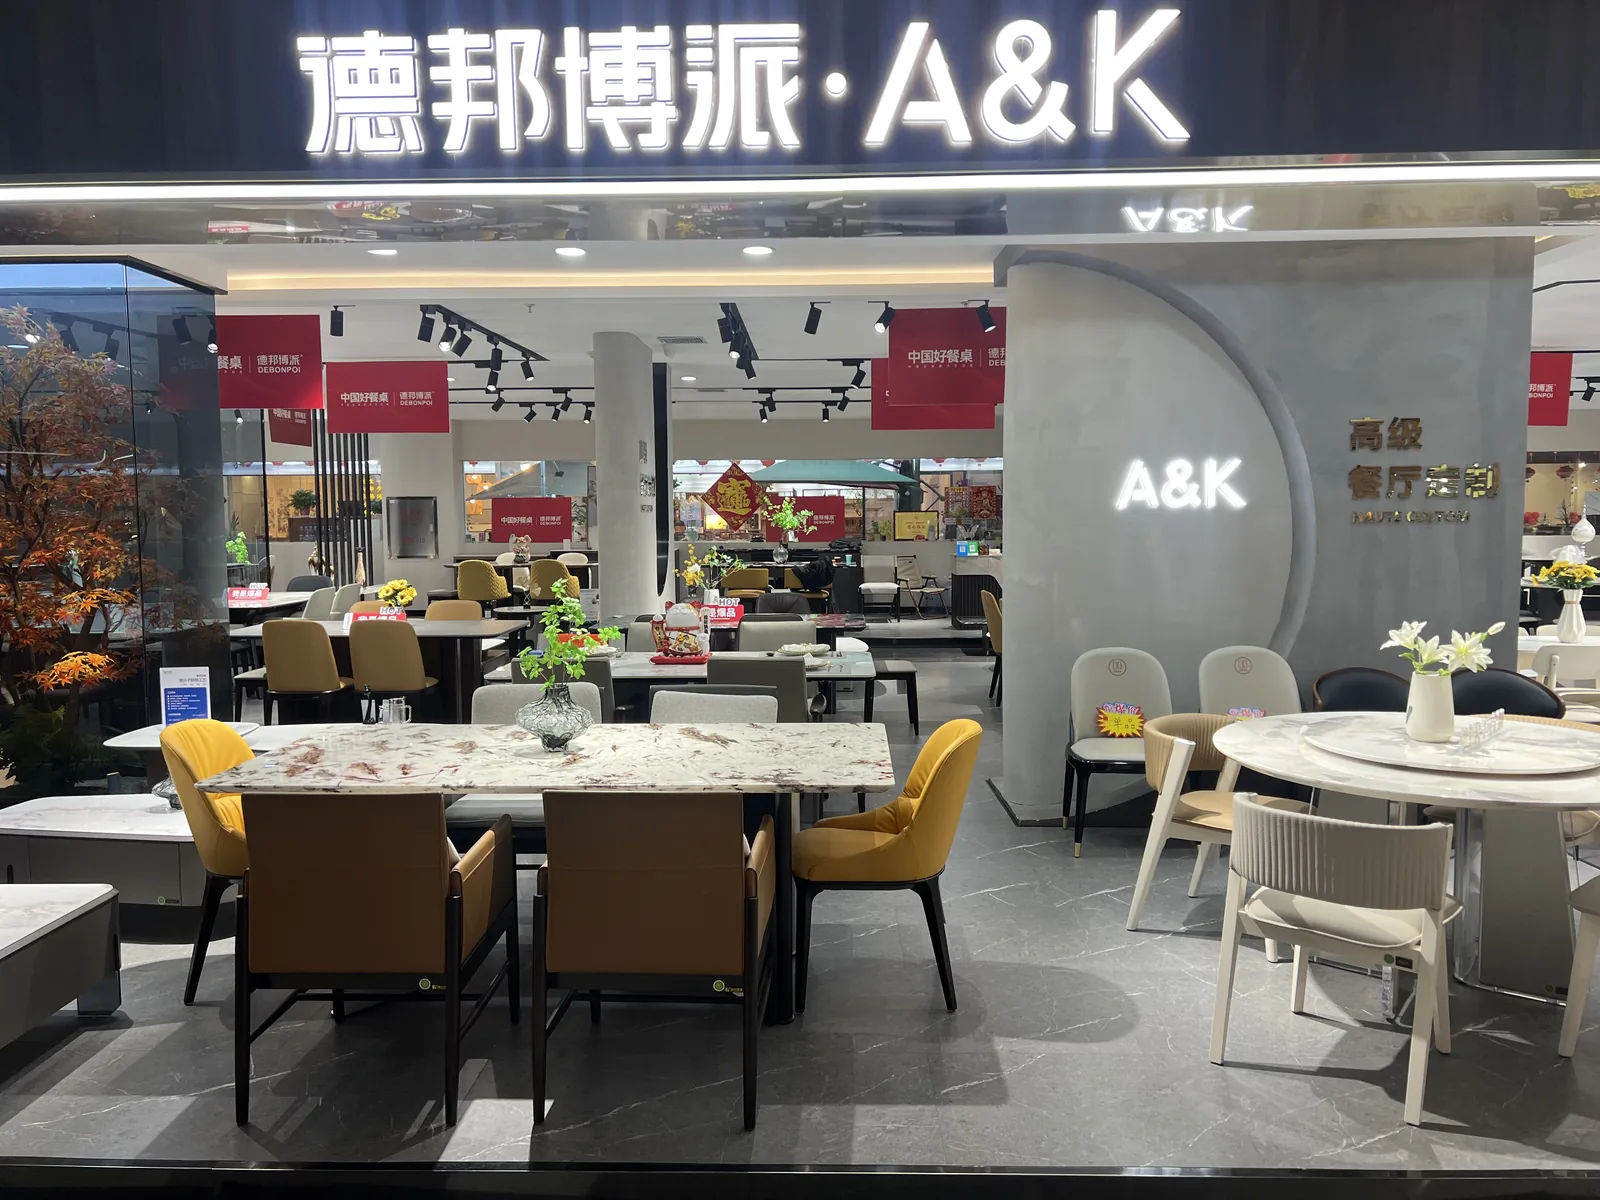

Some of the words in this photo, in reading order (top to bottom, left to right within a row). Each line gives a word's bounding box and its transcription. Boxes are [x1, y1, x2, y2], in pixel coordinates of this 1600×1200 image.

[256, 354, 300, 366] 德邦博派
[908, 349, 973, 364] 中国好餐桌
[257, 366, 301, 374] DEBONPOI
[340, 392, 389, 404] 中国好餐桌
[399, 391, 432, 400] 德邦博派
[1348, 416, 1423, 451] 高级
[1115, 458, 1247, 510] A&K
[1352, 510, 1402, 524] HAUTE
[719, 598, 740, 606] HOT
